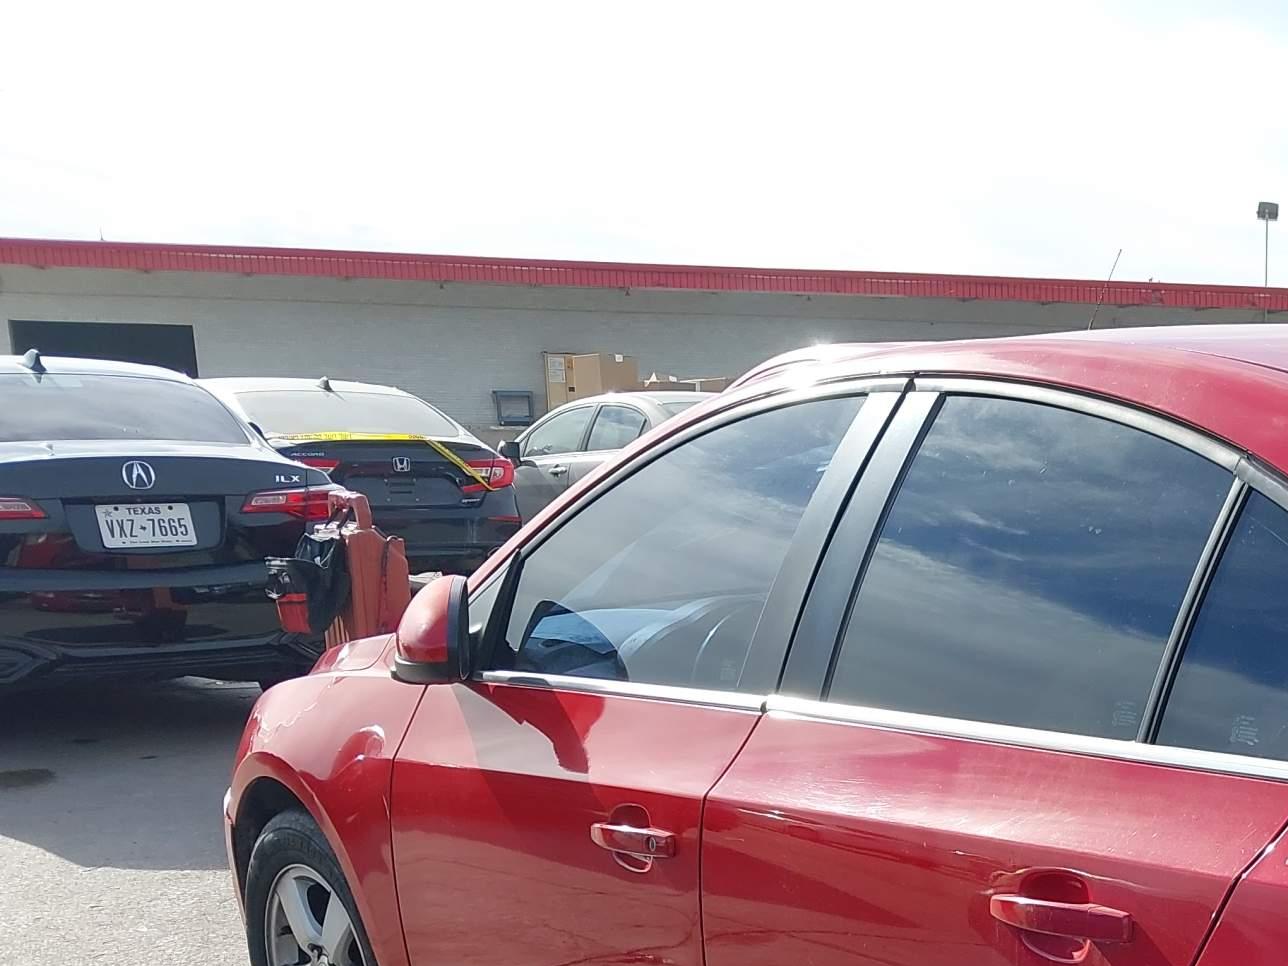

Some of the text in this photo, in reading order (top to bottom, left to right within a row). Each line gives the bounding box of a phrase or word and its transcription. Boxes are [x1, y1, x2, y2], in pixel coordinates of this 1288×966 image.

[275, 475, 300, 483] ILX
[125, 506, 161, 515] TEXAS
[105, 517, 188, 539] VXZ 7665
